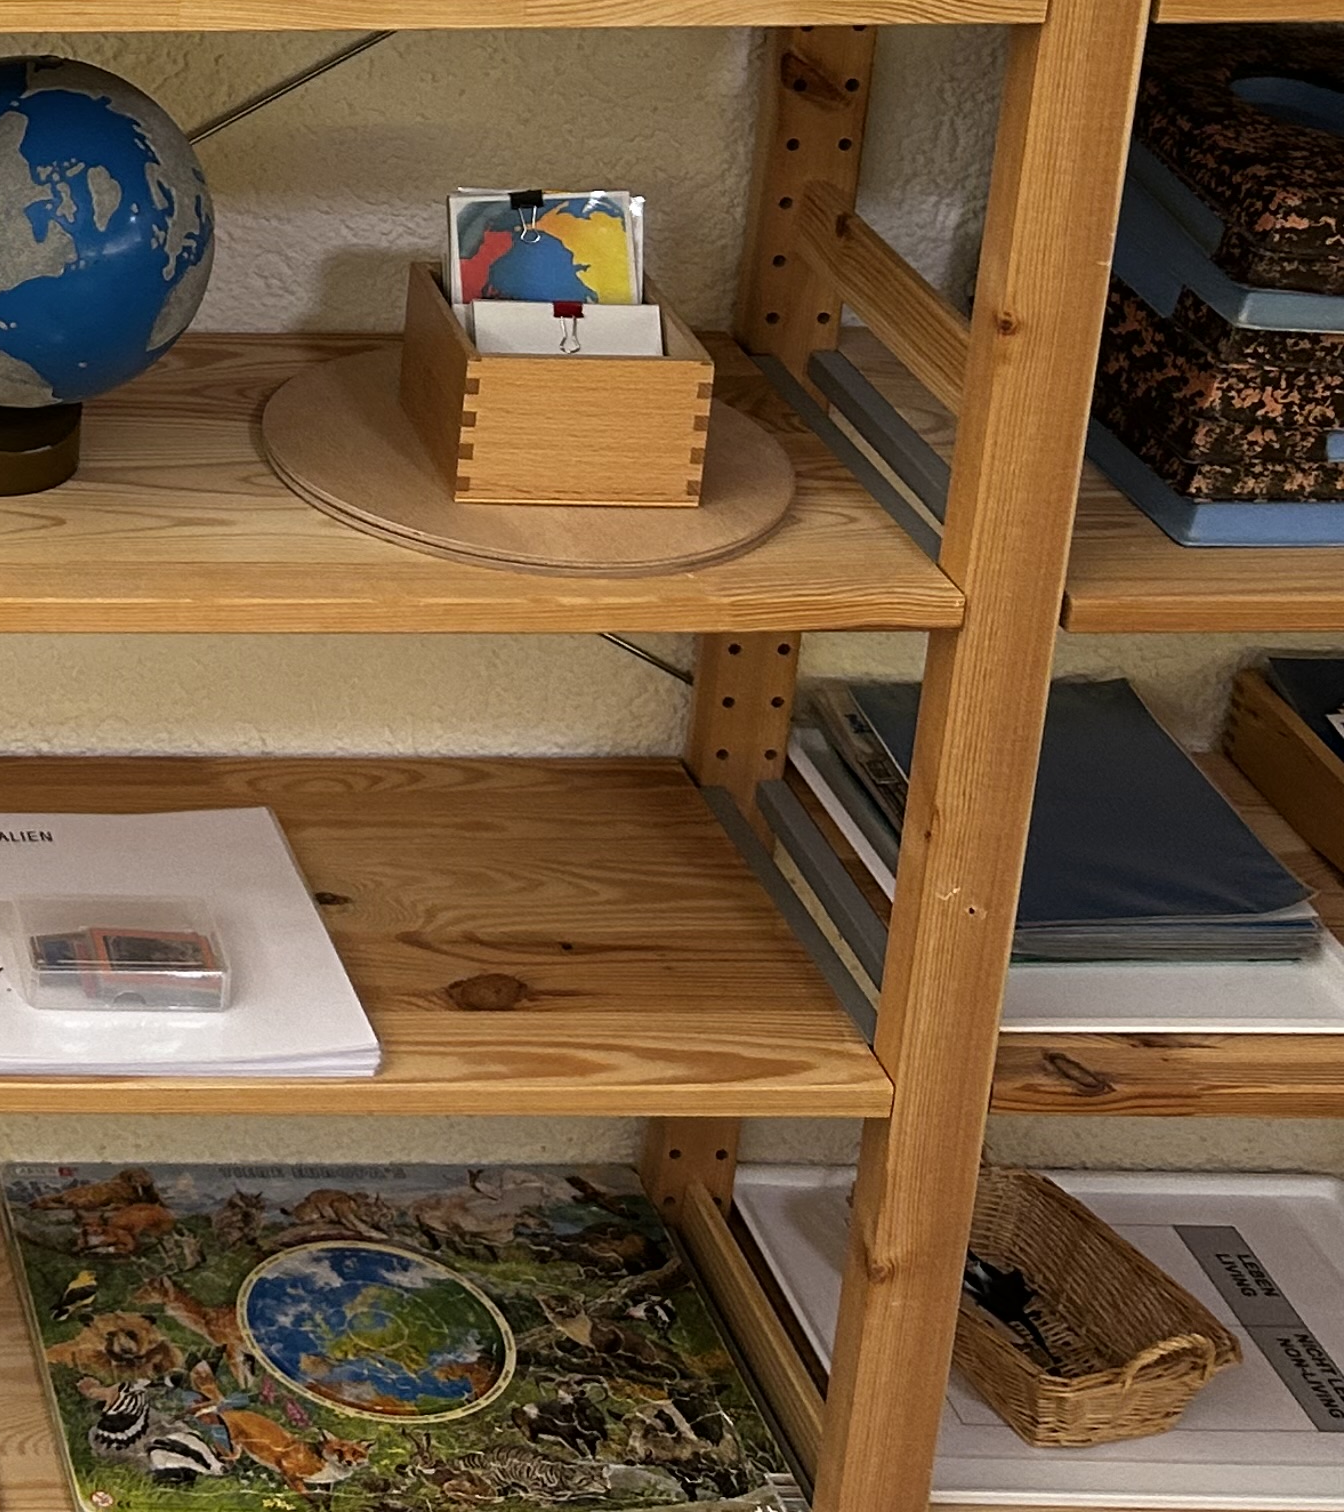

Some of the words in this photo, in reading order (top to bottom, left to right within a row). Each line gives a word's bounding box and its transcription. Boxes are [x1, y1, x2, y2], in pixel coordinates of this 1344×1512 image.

[1215, 1253, 1258, 1297] LIVING
[1237, 1254, 1281, 1298] LEBEN
[1293, 1334, 1338, 1376] NICHT
[1275, 1337, 1344, 1419] NON-LIVING
